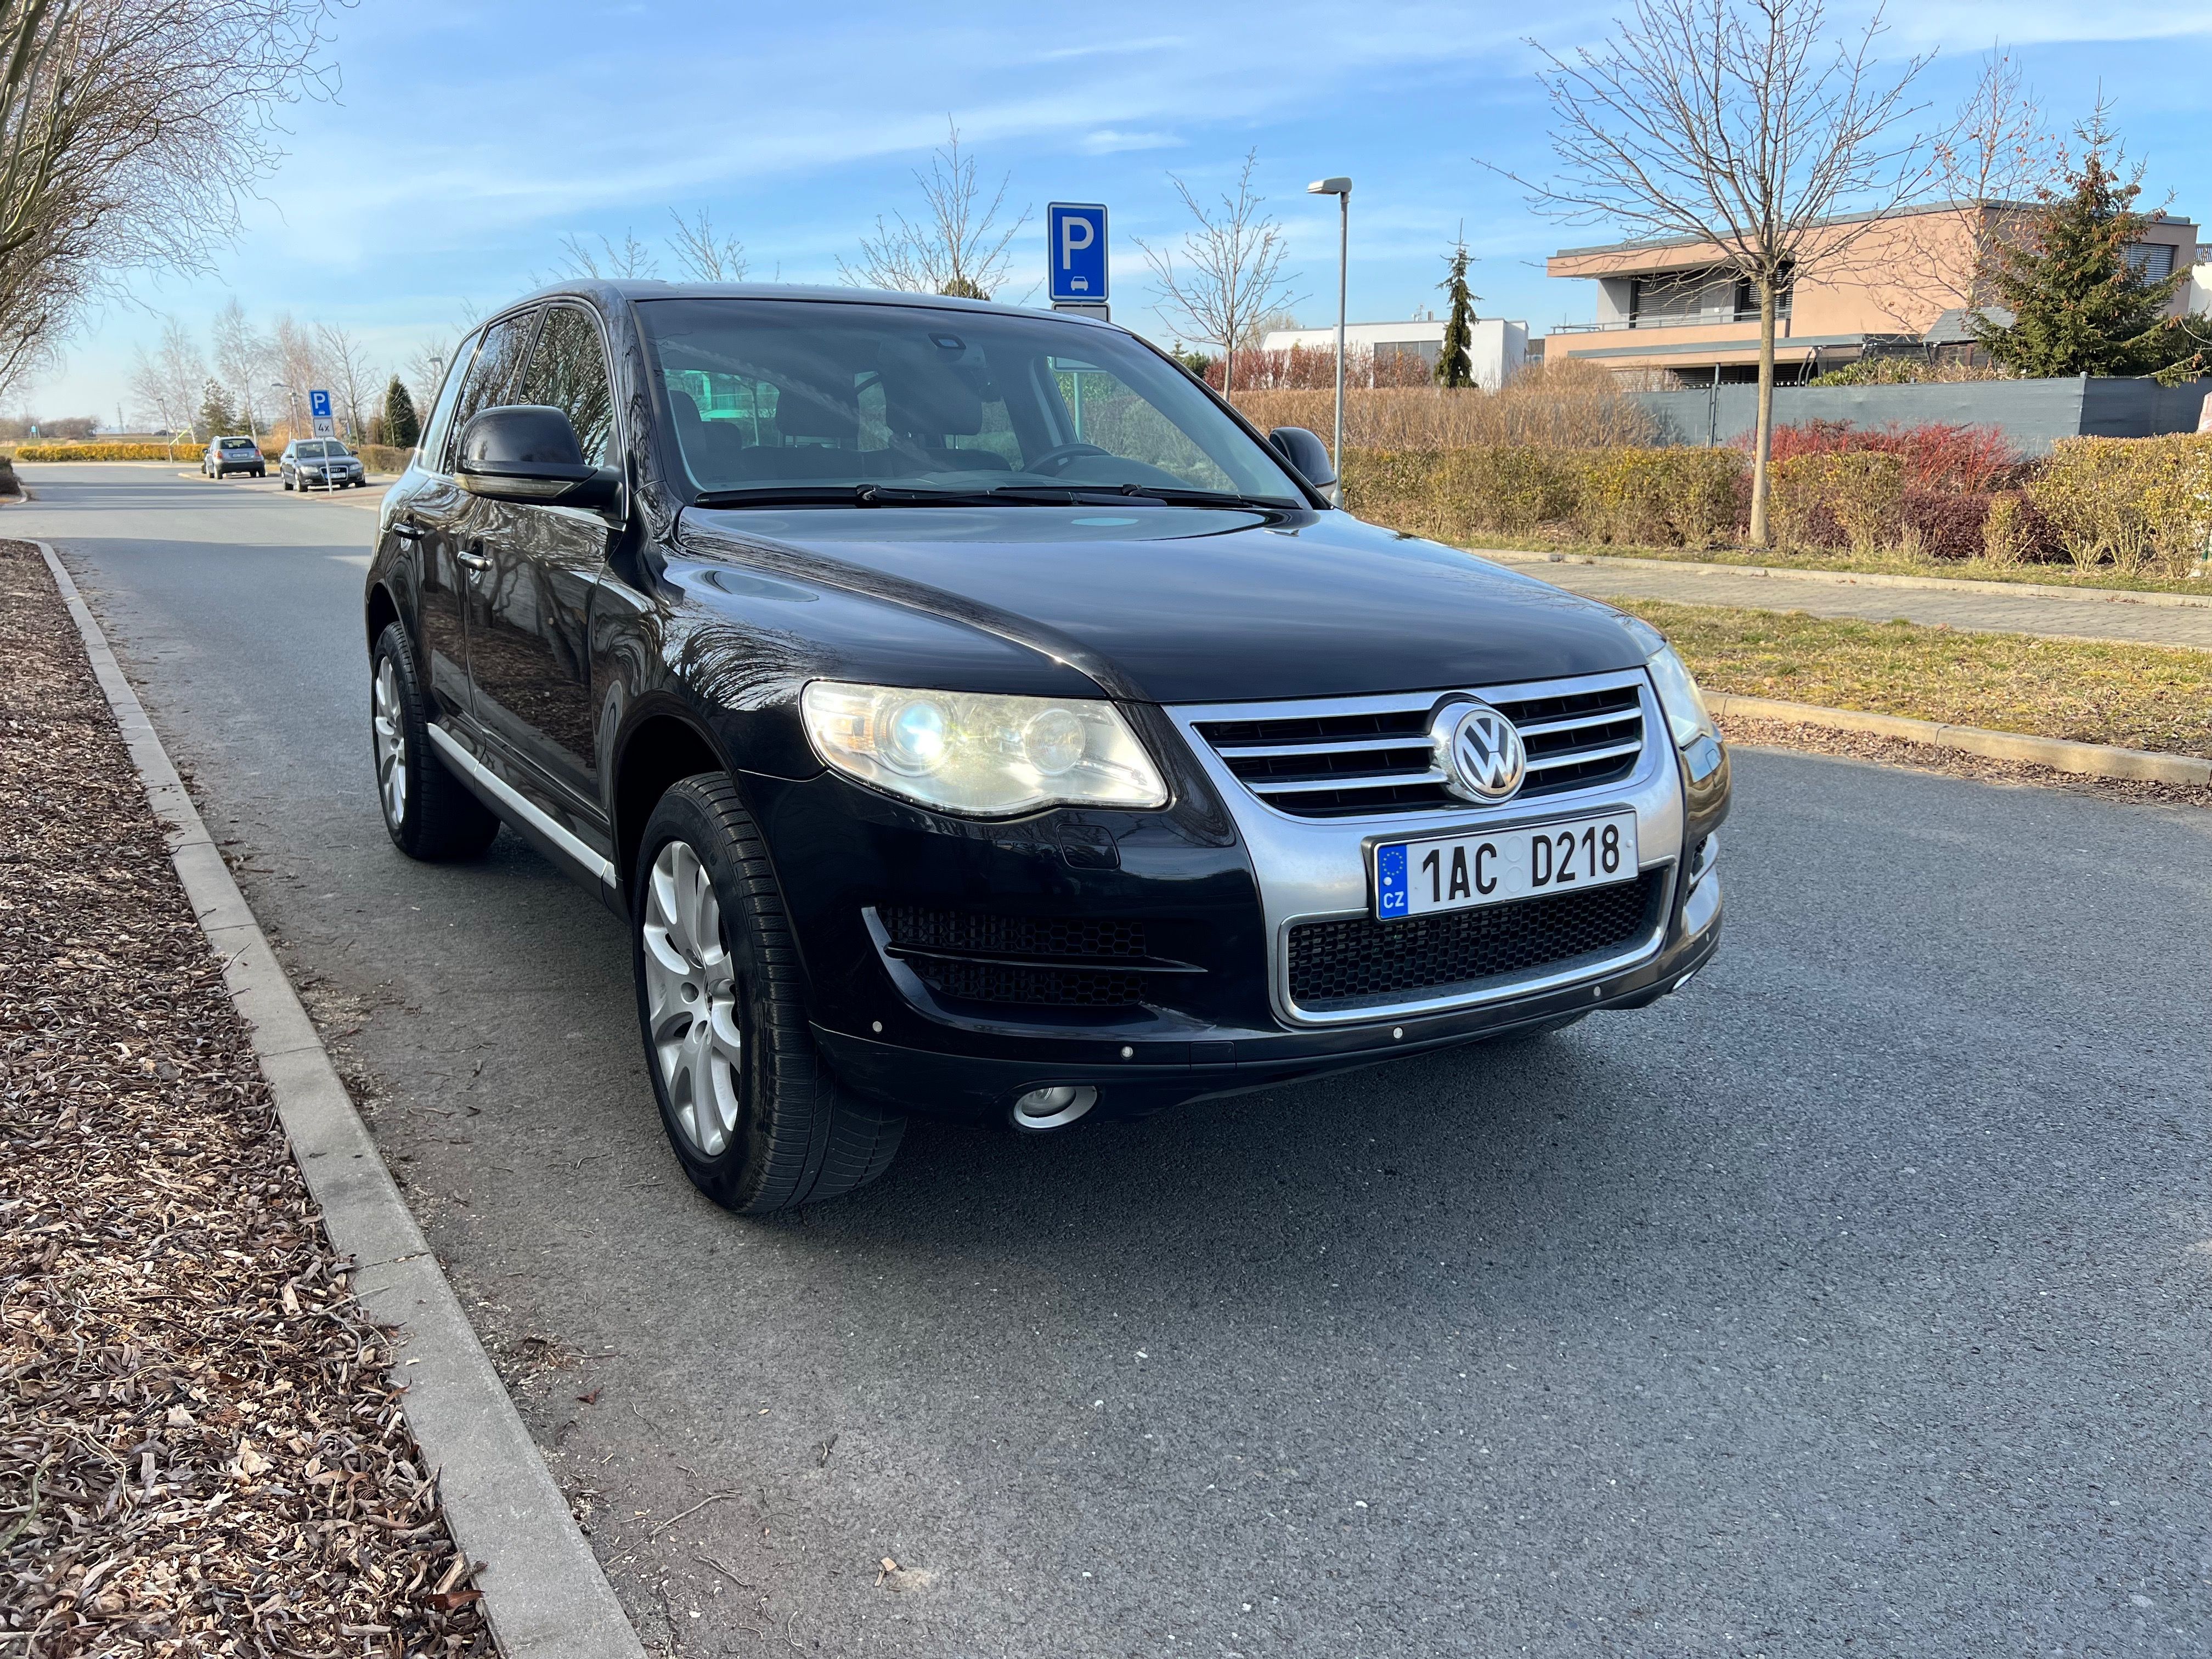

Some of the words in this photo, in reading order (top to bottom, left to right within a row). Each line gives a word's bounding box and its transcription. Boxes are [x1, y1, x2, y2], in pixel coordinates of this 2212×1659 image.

[1062, 216, 1094, 270] P
[313, 392, 326, 409] P
[1454, 710, 1523, 795] VW
[1423, 843, 1497, 902] 1AC
[1532, 823, 1619, 888] D218
[1383, 891, 1405, 909] CZ
